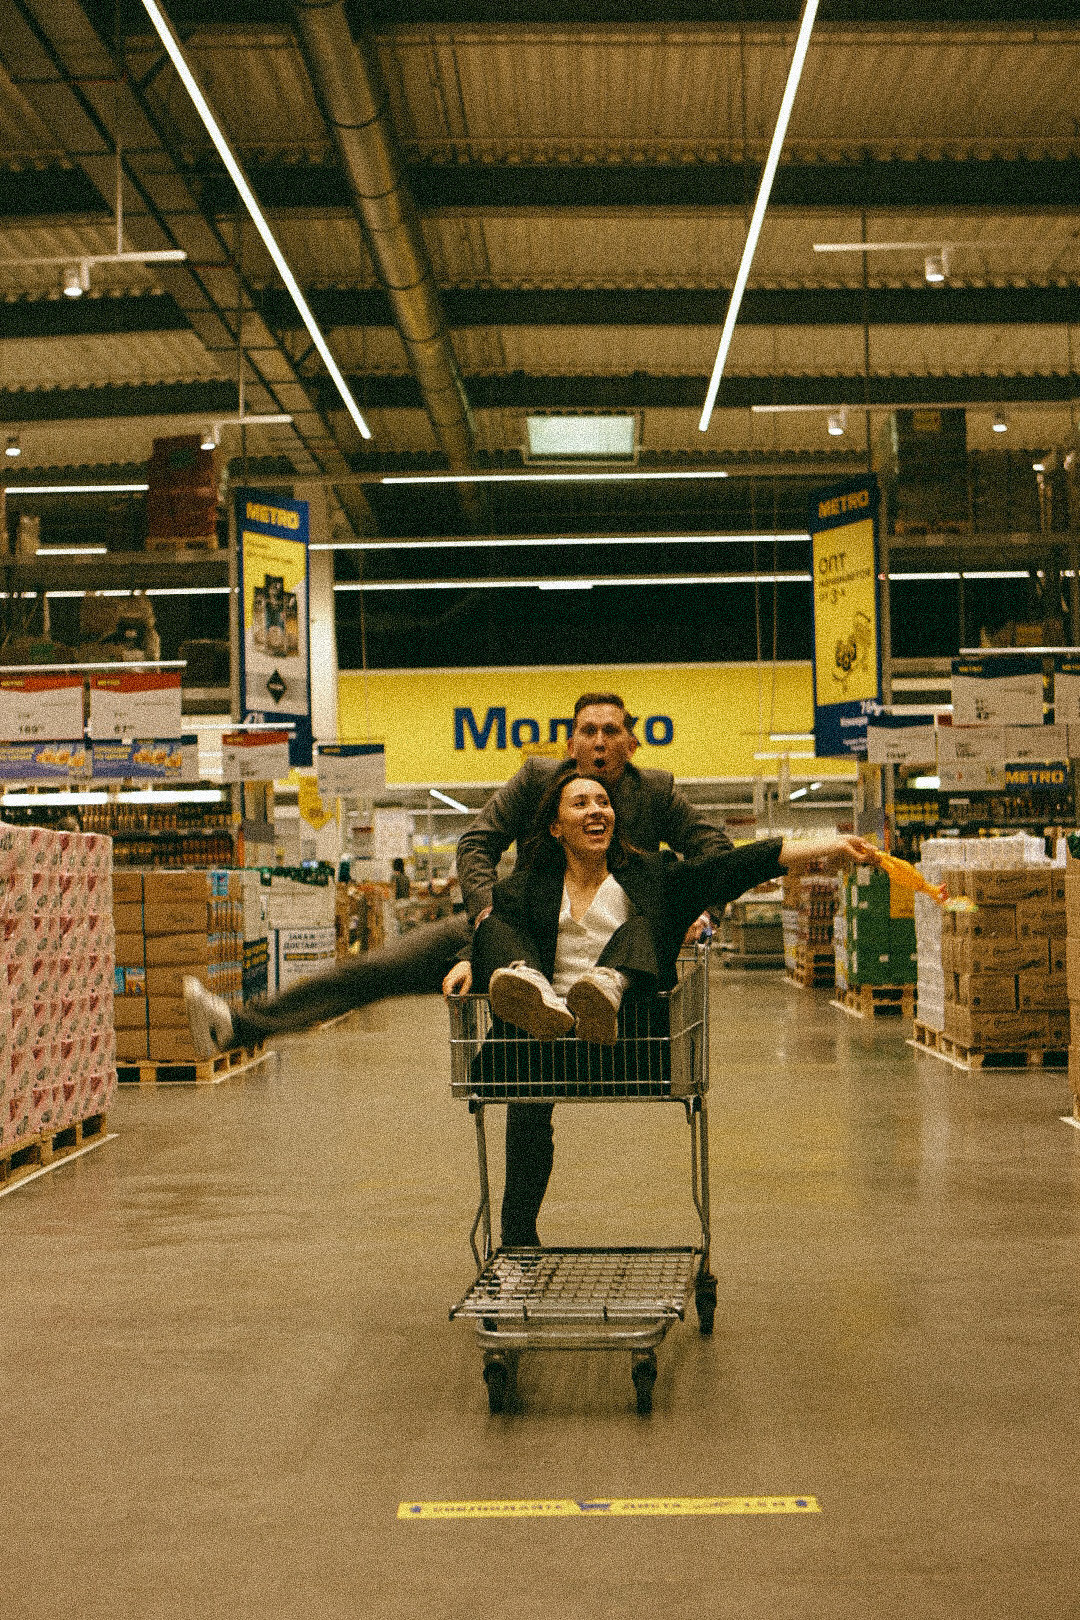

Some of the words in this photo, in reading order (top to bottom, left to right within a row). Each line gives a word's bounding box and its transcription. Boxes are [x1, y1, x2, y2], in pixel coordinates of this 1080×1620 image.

[246, 502, 300, 530] METRO
[818, 489, 869, 518] METRO
[1005, 769, 1065, 785] METRO
